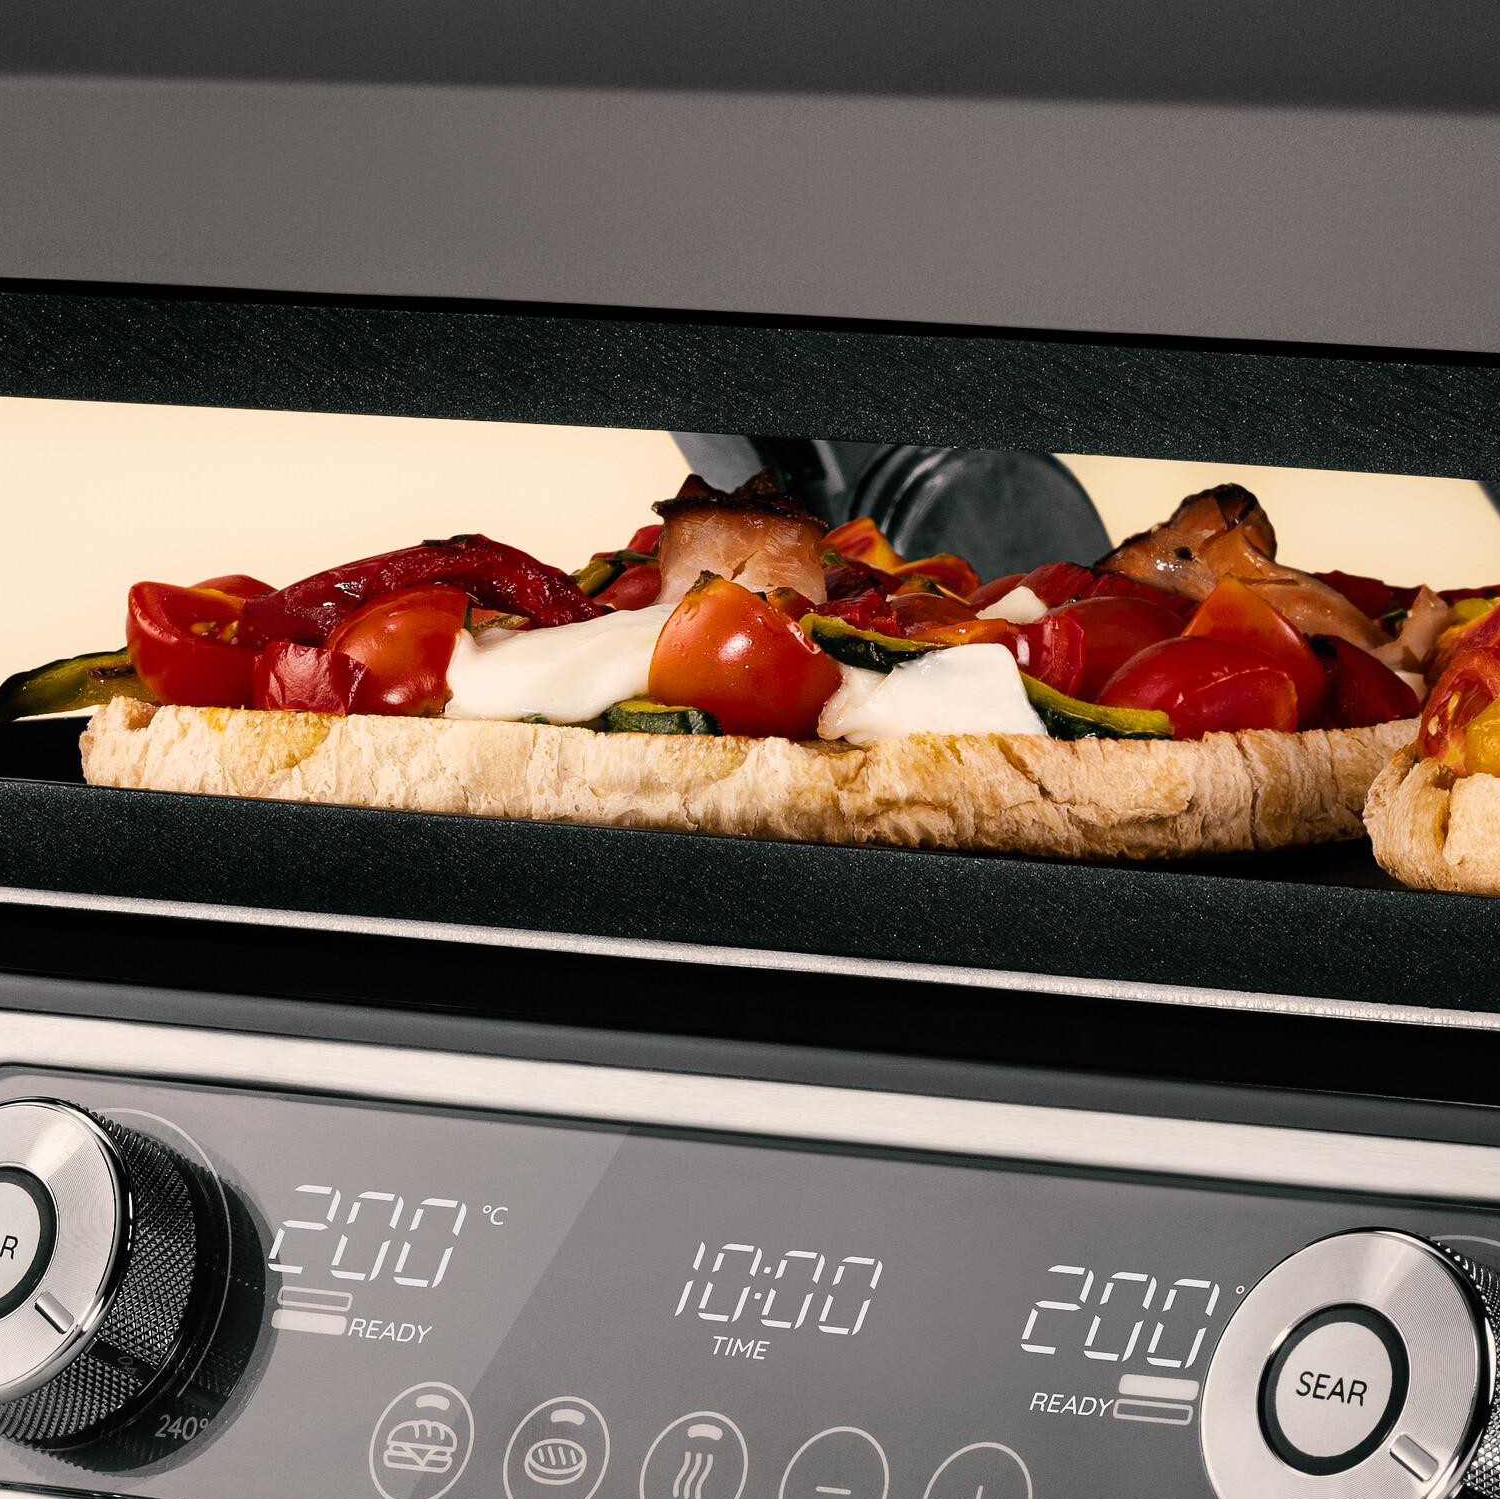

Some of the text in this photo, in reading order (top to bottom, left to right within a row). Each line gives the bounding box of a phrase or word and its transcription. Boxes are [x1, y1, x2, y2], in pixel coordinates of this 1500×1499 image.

[267, 1184, 467, 1288] 200
[674, 1241, 883, 1336] 10:00
[348, 1317, 433, 1344] READY
[712, 1335, 771, 1360] TIME
[1029, 1392, 1115, 1417] READY
[1295, 1371, 1368, 1407] SEAR
